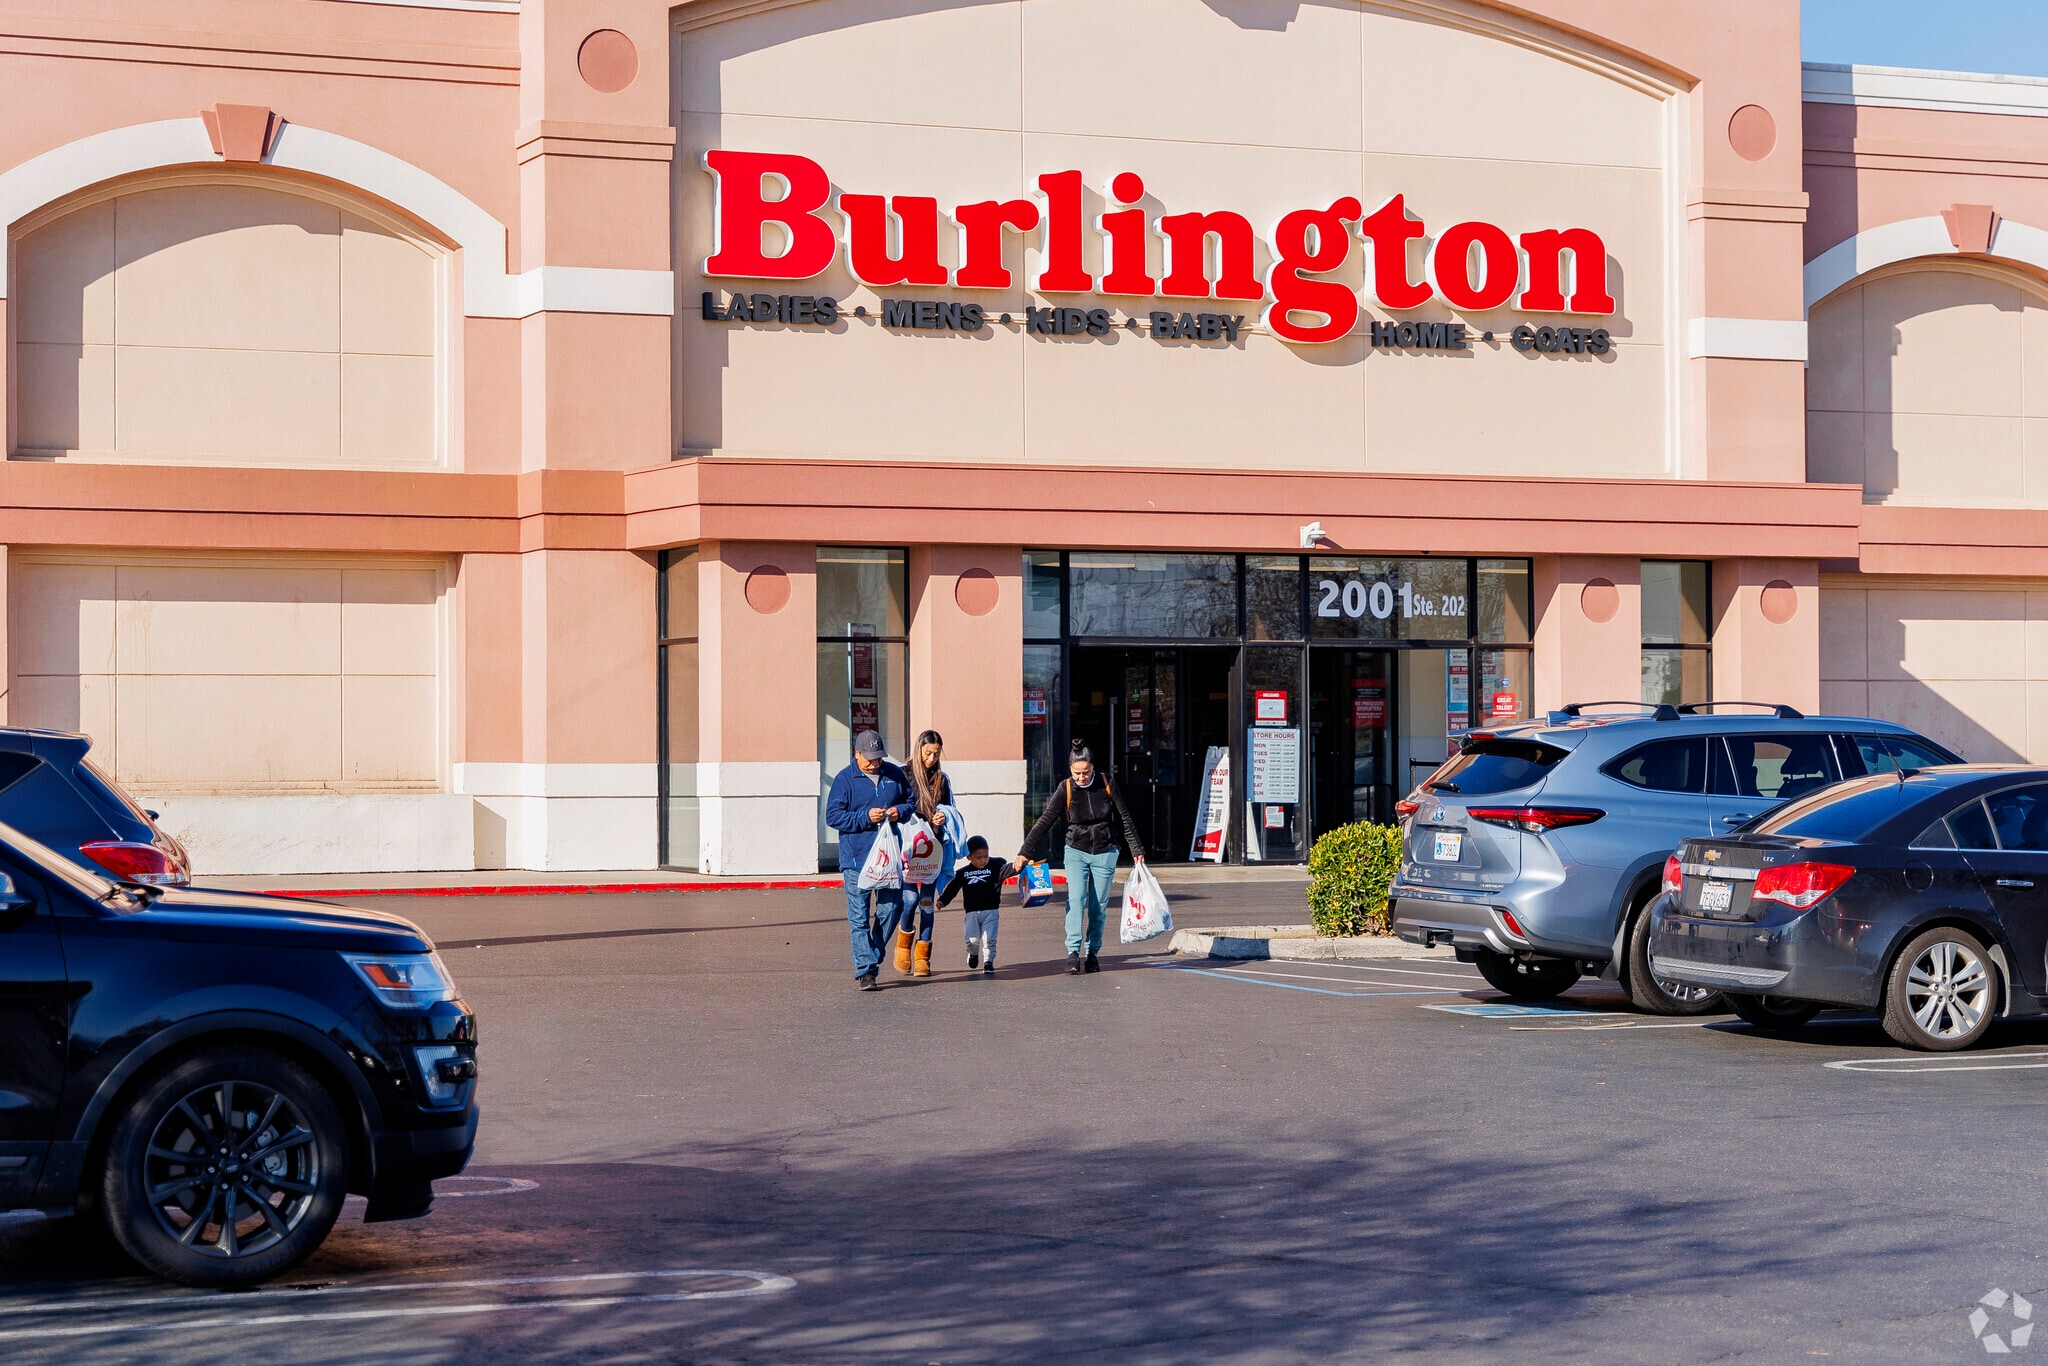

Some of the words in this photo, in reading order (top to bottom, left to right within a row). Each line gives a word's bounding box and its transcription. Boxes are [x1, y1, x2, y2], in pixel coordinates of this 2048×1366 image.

[701, 149, 1616, 344] Burlington
[702, 291, 838, 326] LADIES
[881, 300, 984, 332] MENS
[1026, 306, 1111, 336] KIDS
[1150, 311, 1245, 342] BABY
[1371, 321, 1467, 350] HOME
[1510, 325, 1610, 355] COATS
[1317, 579, 1413, 619] 2001
[1413, 593, 1438, 616] Ste.
[1441, 595, 1465, 617] 202
[1210, 778, 1224, 786] TEAM
[1219, 768, 1229, 777] OUR
[963, 868, 992, 878] Reebok
